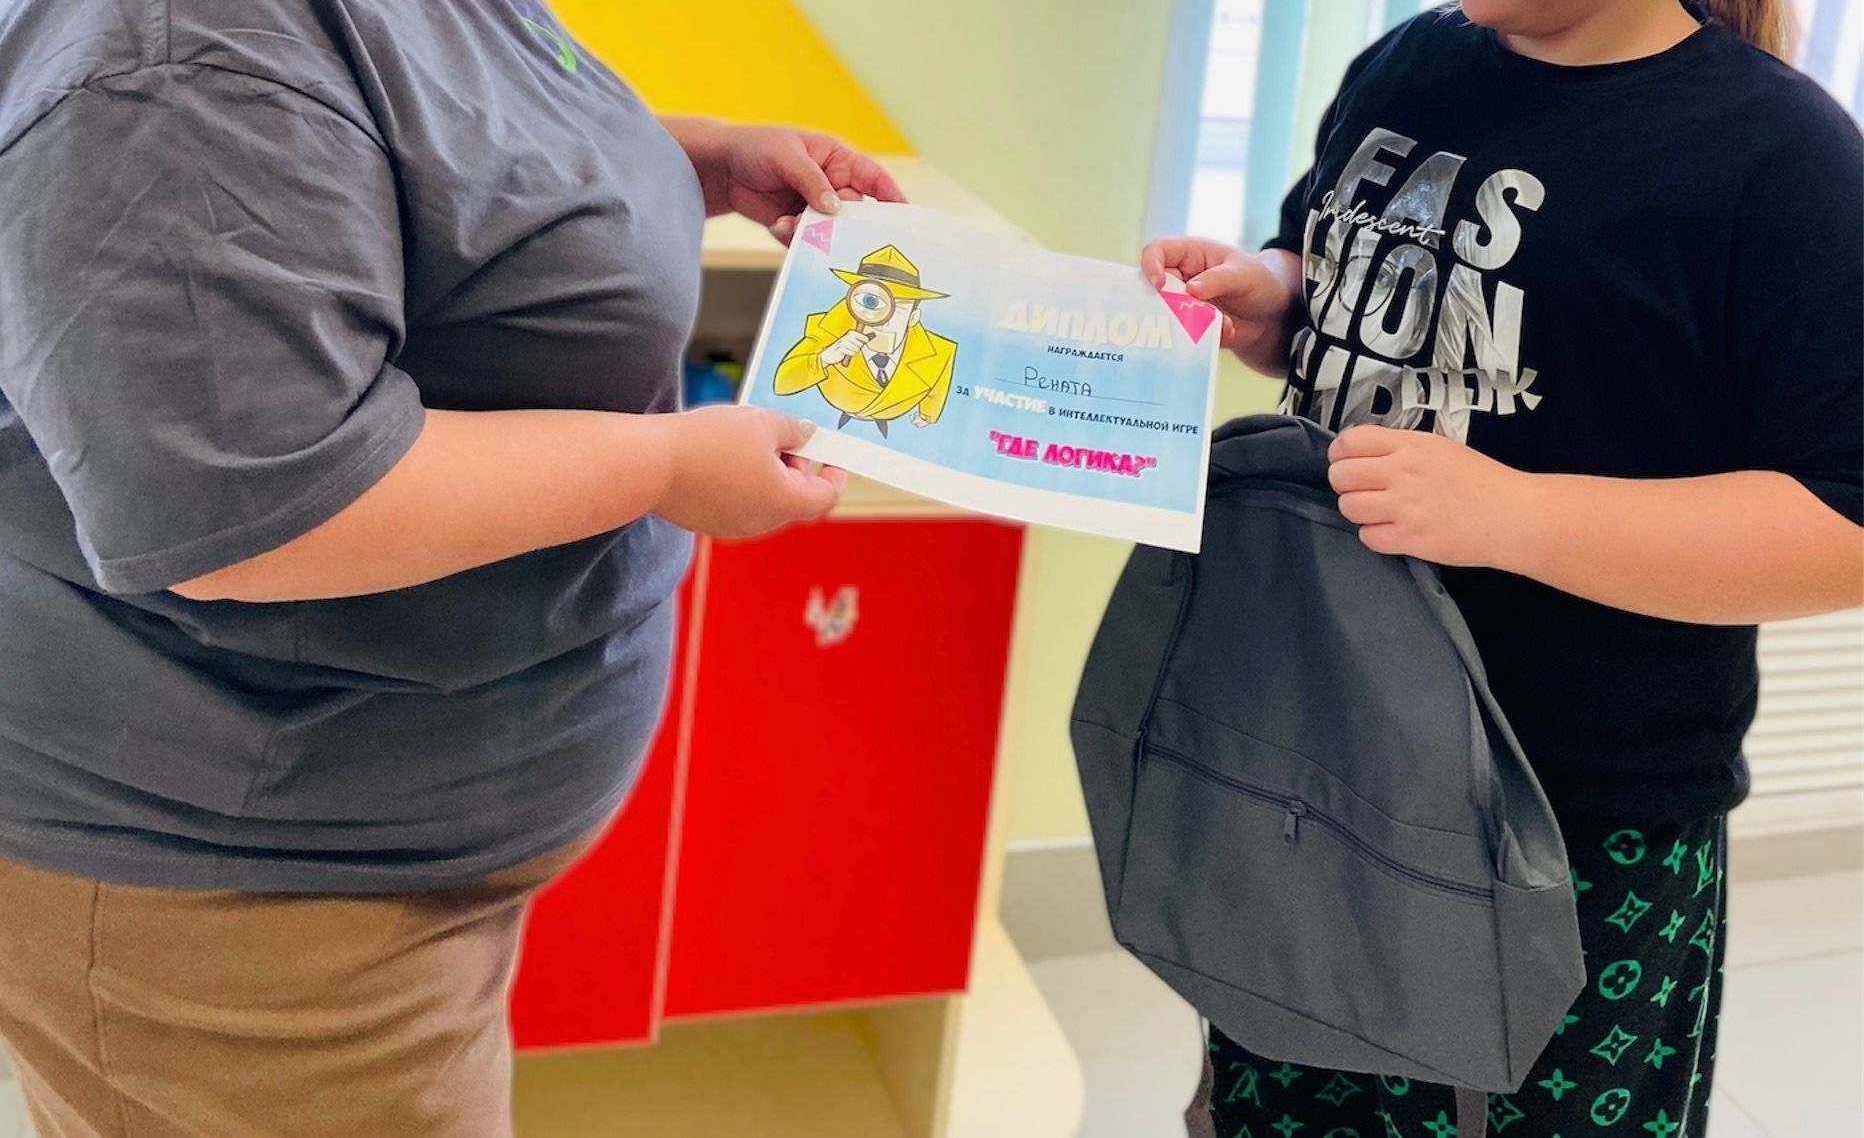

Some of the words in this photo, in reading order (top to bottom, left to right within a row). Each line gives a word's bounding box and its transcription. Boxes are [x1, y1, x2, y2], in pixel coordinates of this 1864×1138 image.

[998, 300, 1174, 350] ДИПЛОМ
[1047, 344, 1124, 362] НАГРАЖДАЕТСЯ
[956, 385, 970, 397] ЗА
[973, 384, 1047, 413] УЧАСТИЕ
[1048, 407, 1056, 416] В
[1058, 408, 1169, 431] ИНТЕЛЛЕКТУАЛЬНОЙ
[1172, 424, 1199, 435] ИГРЕ
[989, 429, 1040, 460] "ГДЕ
[1042, 443, 1157, 477] ЛОГИКА?"
